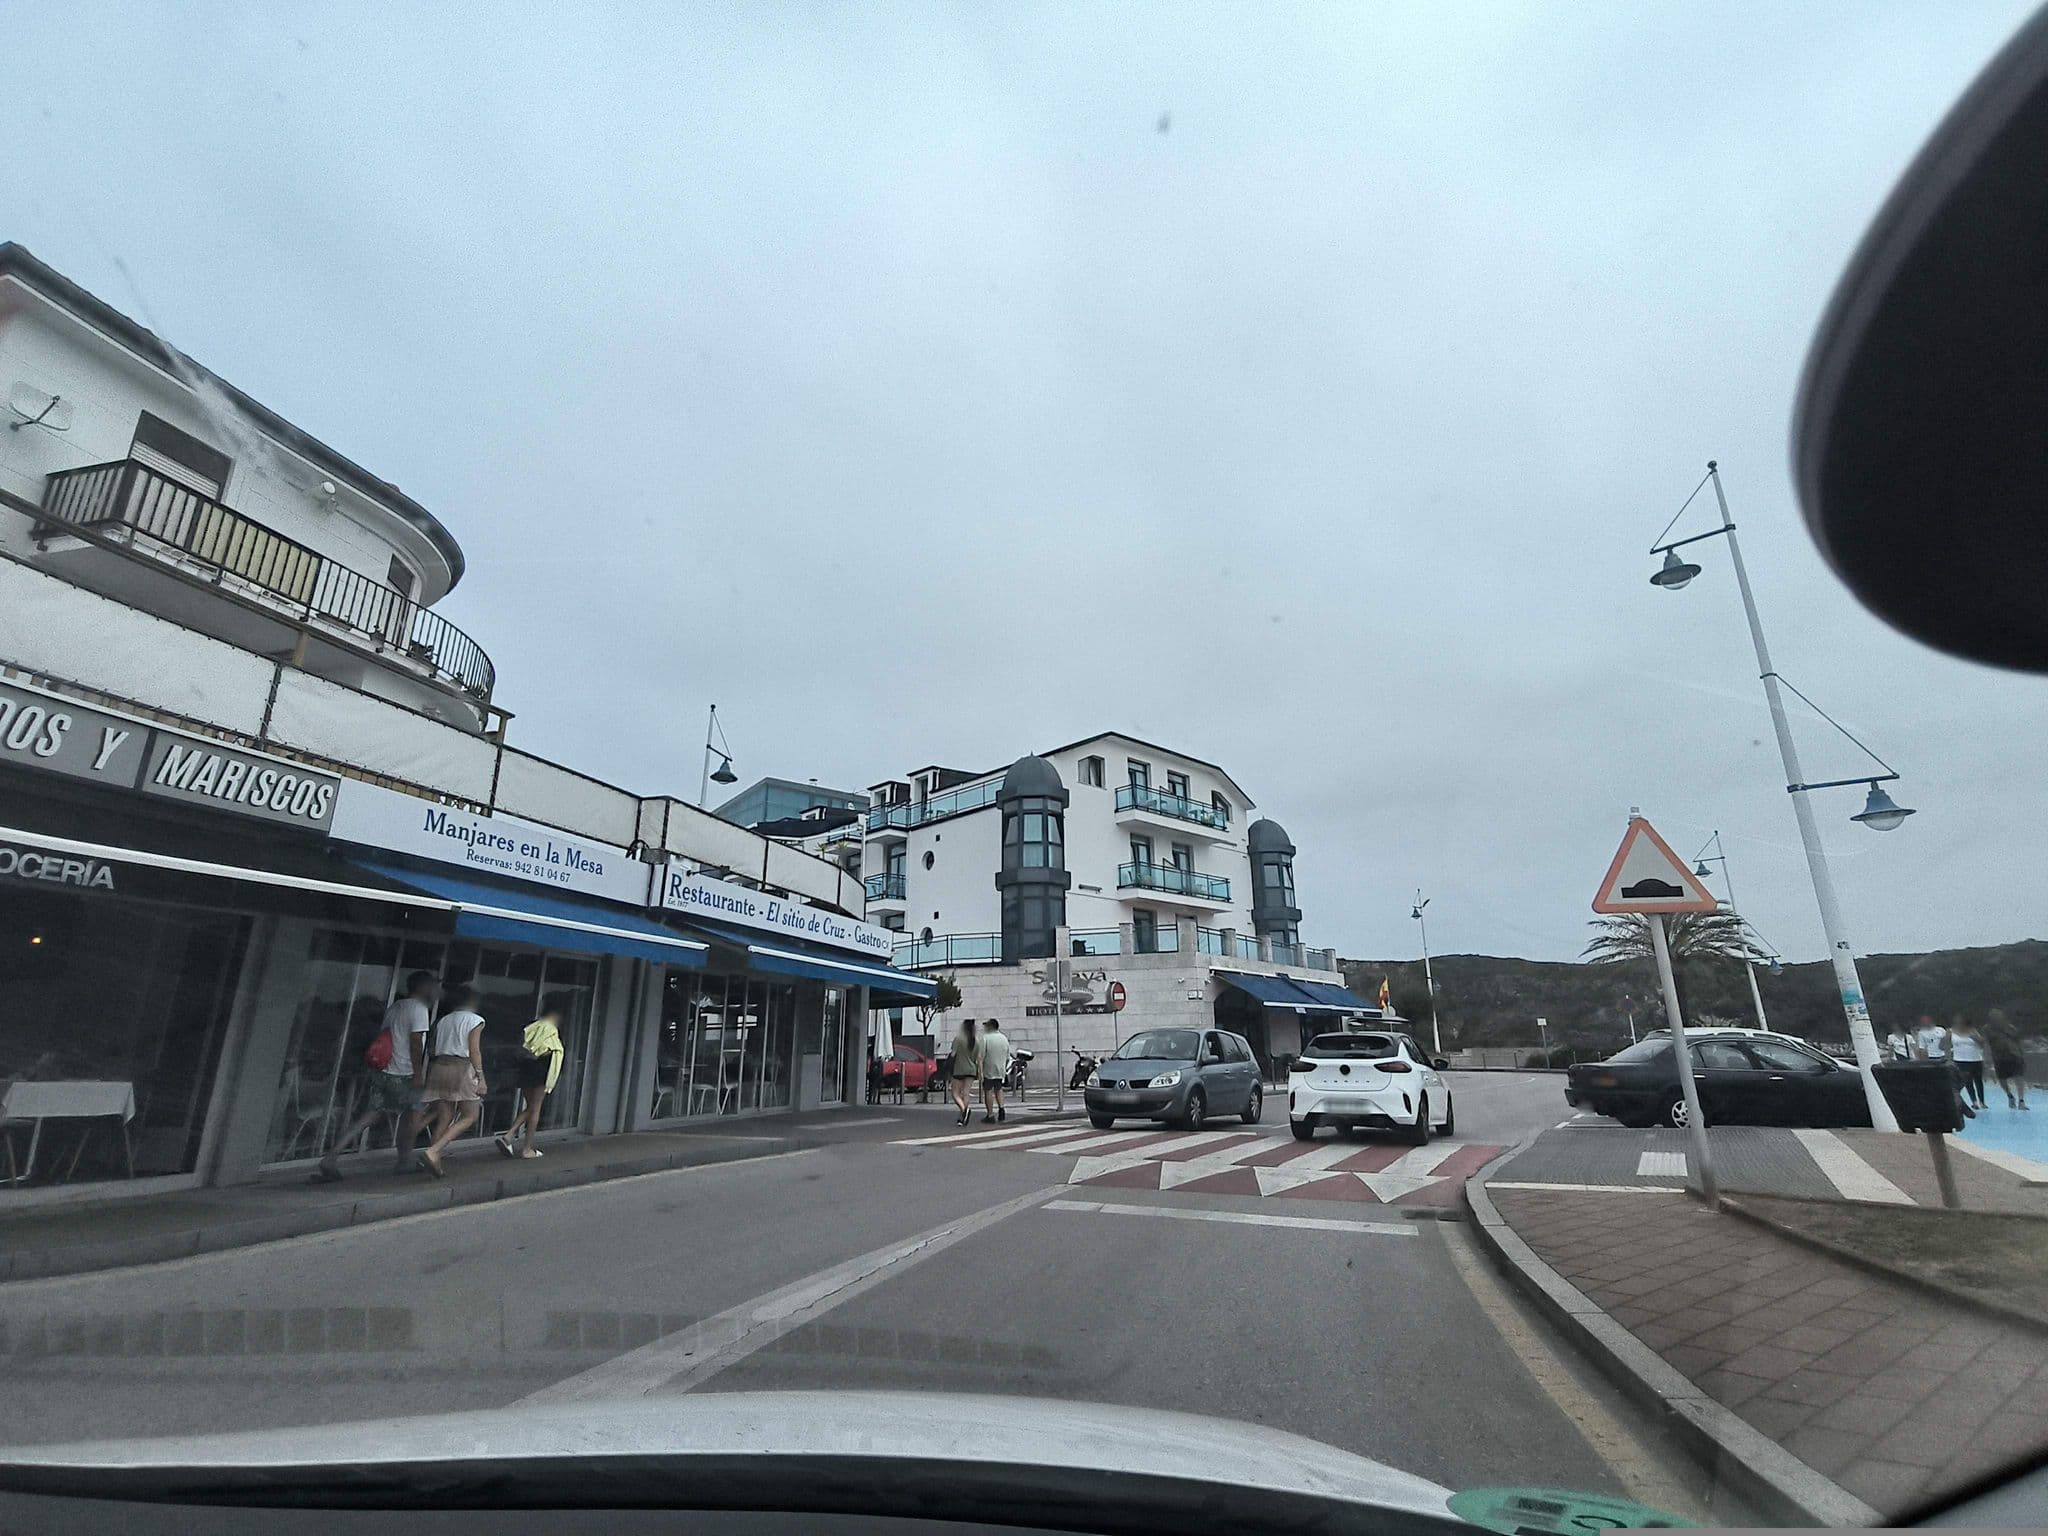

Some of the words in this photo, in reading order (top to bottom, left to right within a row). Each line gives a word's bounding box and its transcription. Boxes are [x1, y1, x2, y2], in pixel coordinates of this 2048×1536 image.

[93, 727, 130, 770] Y
[155, 745, 334, 820] MARISCOS
[424, 809, 514, 852] Manjares
[520, 843, 540, 859] en
[545, 842, 560, 864] la
[565, 847, 604, 876] Mesa
[466, 849, 513, 870] Reservas:
[514, 860, 532, 875] 942
[534, 865, 545, 878] 81
[547, 868, 558, 881] 04
[559, 872, 571, 883] 67
[669, 873, 755, 918] Restaurante
[767, 901, 780, 922] El
[782, 911, 805, 930] sitio
[808, 914, 821, 933] de
[823, 918, 845, 939] Cruz
[855, 925, 881, 948] Gastro
